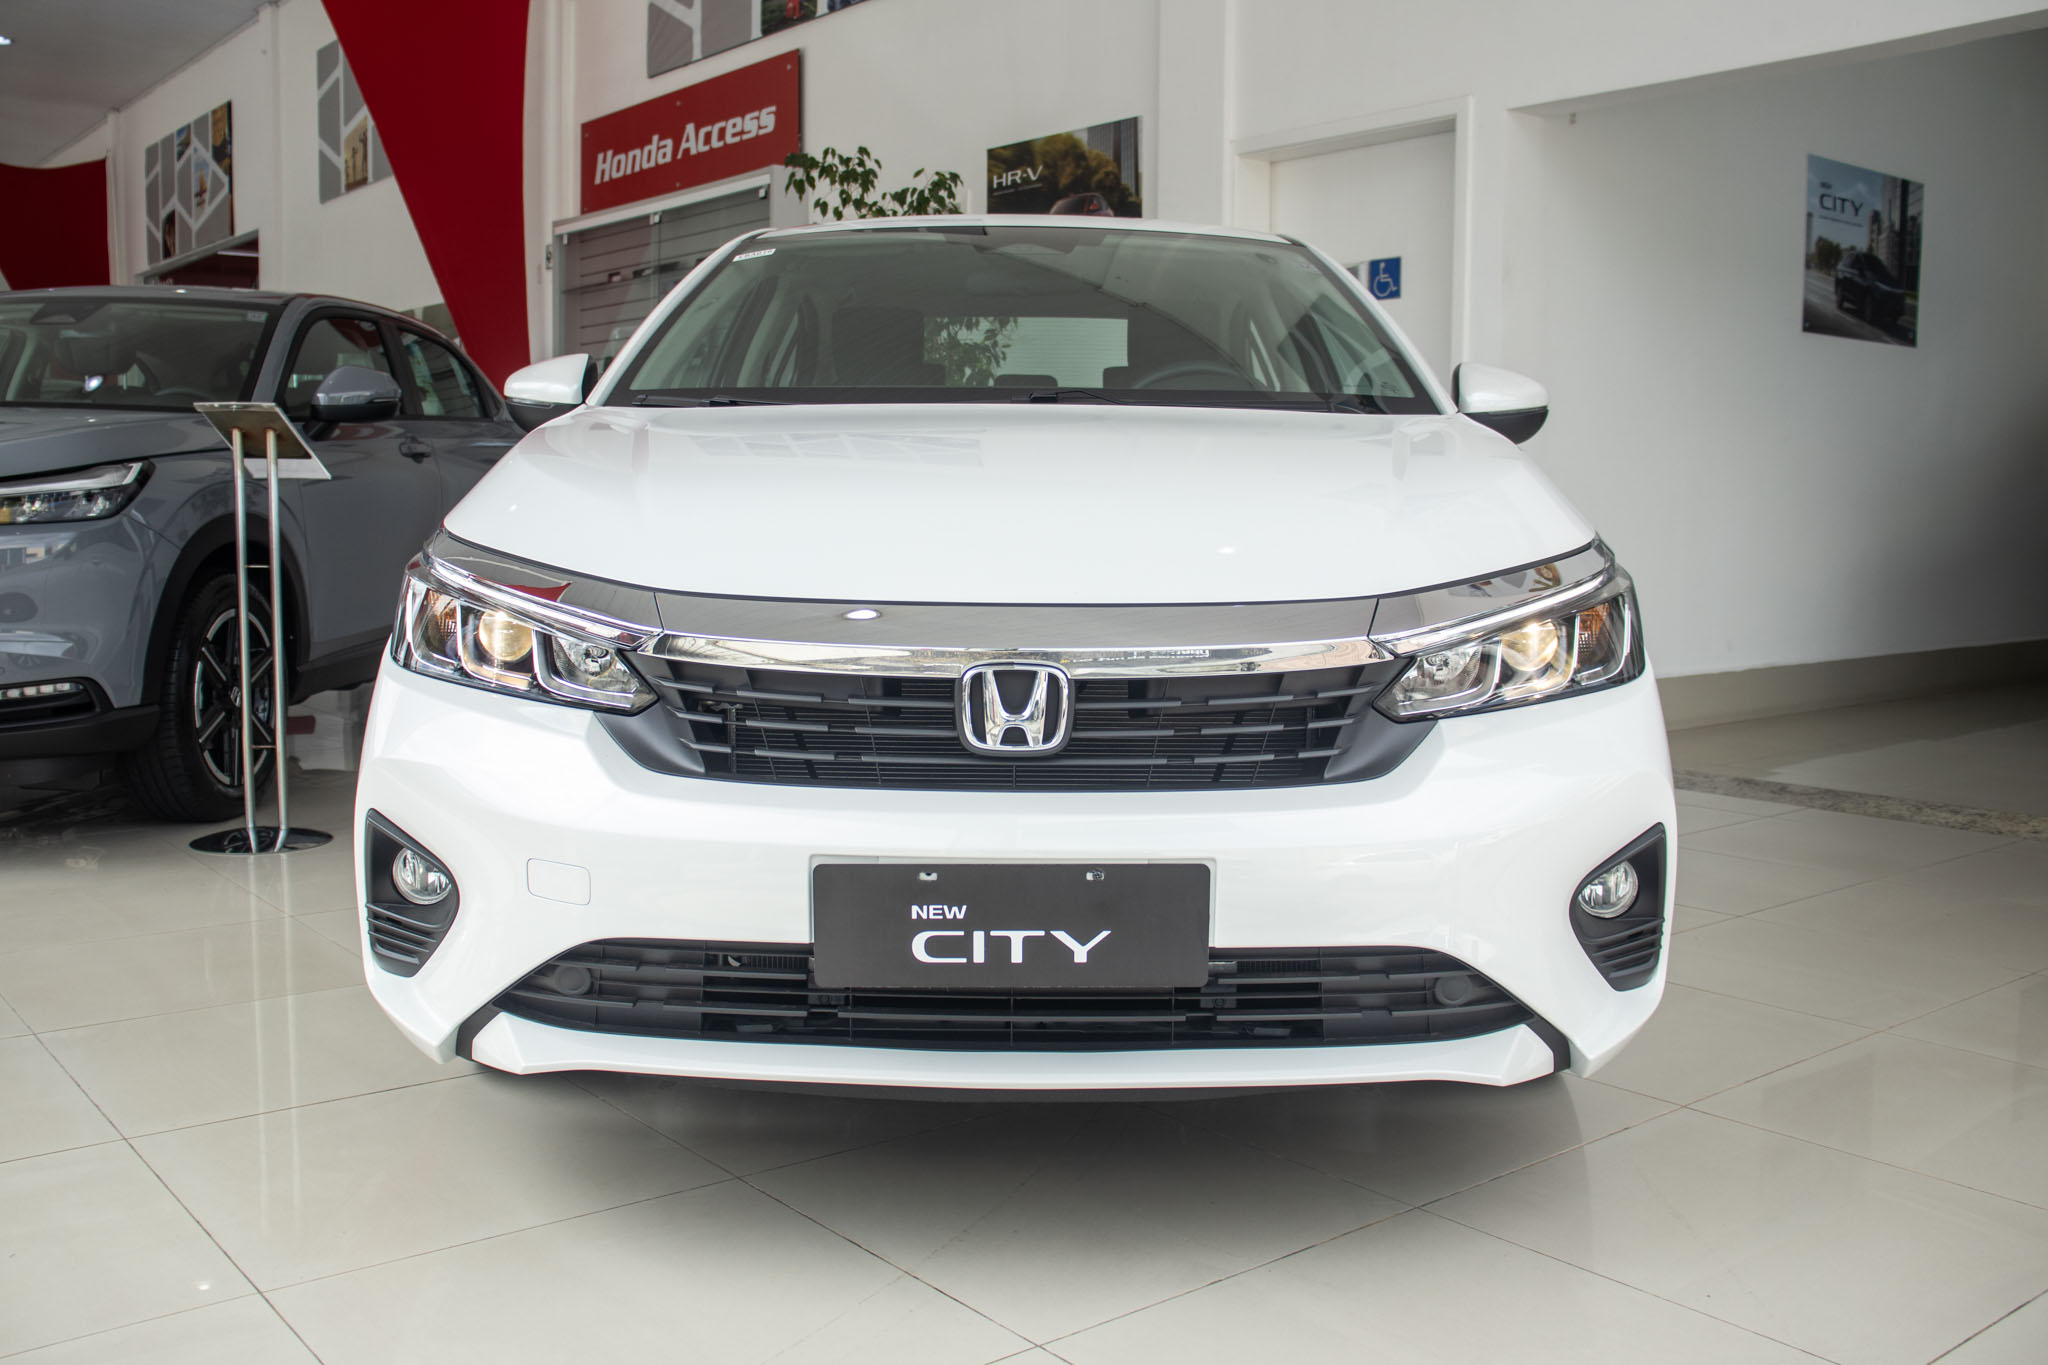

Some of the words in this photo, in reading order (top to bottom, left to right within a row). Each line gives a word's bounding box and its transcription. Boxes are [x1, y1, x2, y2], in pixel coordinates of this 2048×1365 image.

[594, 134, 673, 185] Honda
[677, 105, 777, 160] Access
[993, 164, 1043, 189] HR-V
[1819, 193, 1864, 217] CITY
[911, 905, 967, 919] NEW
[911, 930, 1112, 964] CITY
